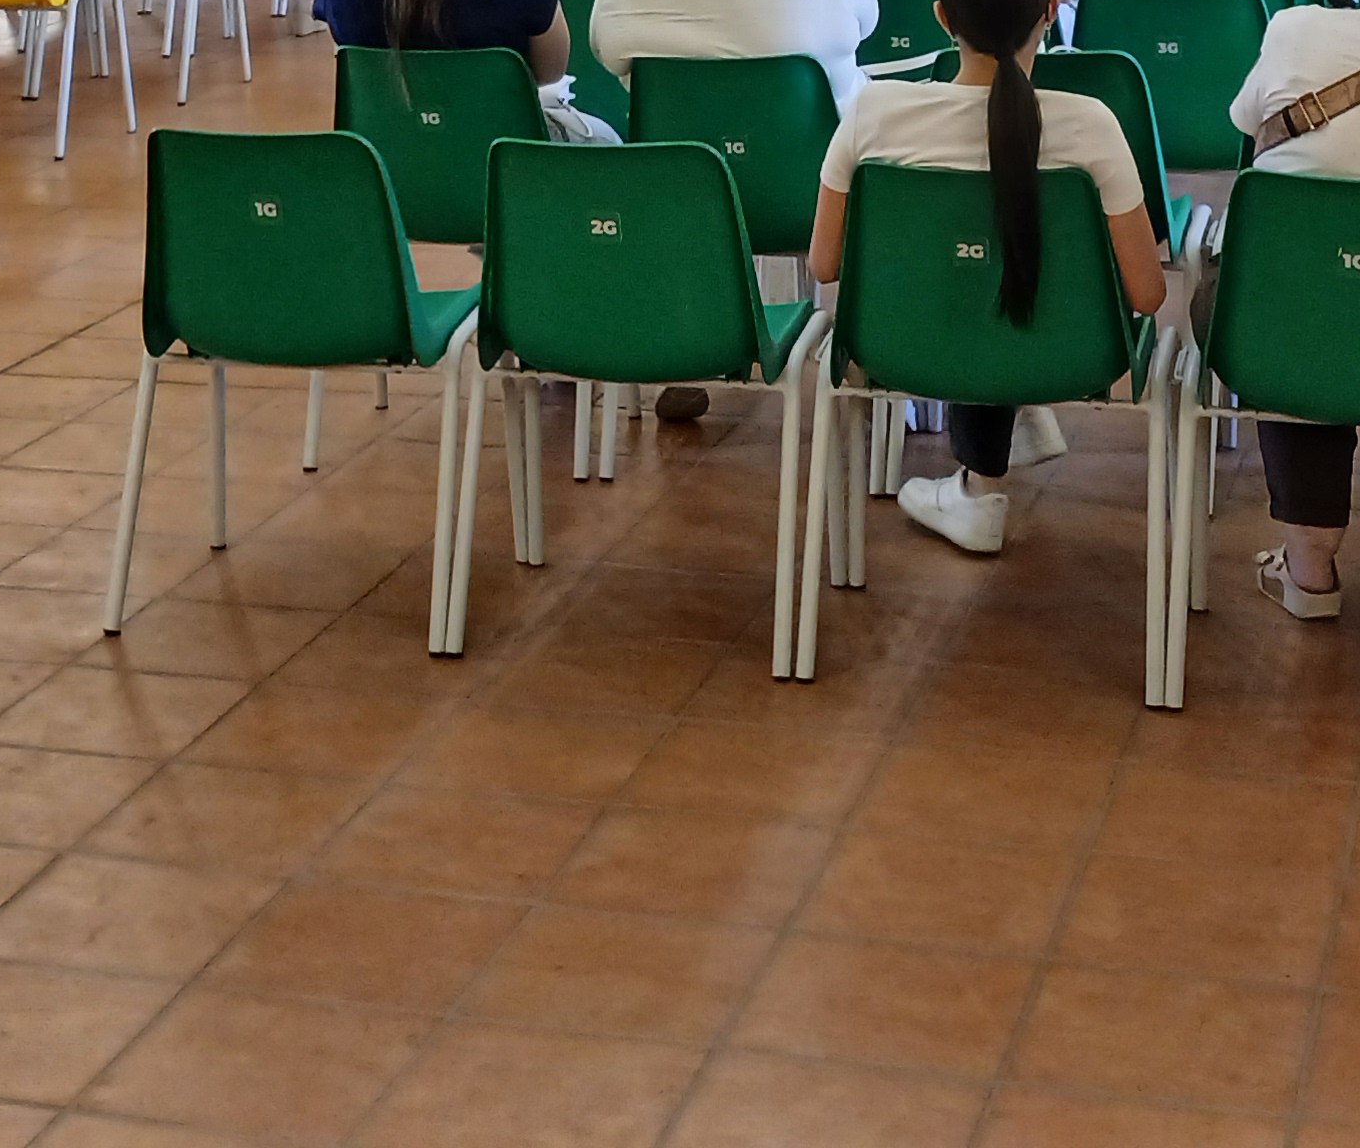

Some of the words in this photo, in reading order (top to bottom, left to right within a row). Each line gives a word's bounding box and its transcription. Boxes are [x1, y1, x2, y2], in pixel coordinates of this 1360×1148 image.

[890, 36, 910, 48] 3G
[1157, 42, 1179, 54] 3G
[420, 112, 440, 125] 1G
[724, 141, 745, 154] 1G
[254, 202, 277, 217] 1G
[590, 219, 617, 235] 2G
[956, 243, 984, 259] 2G
